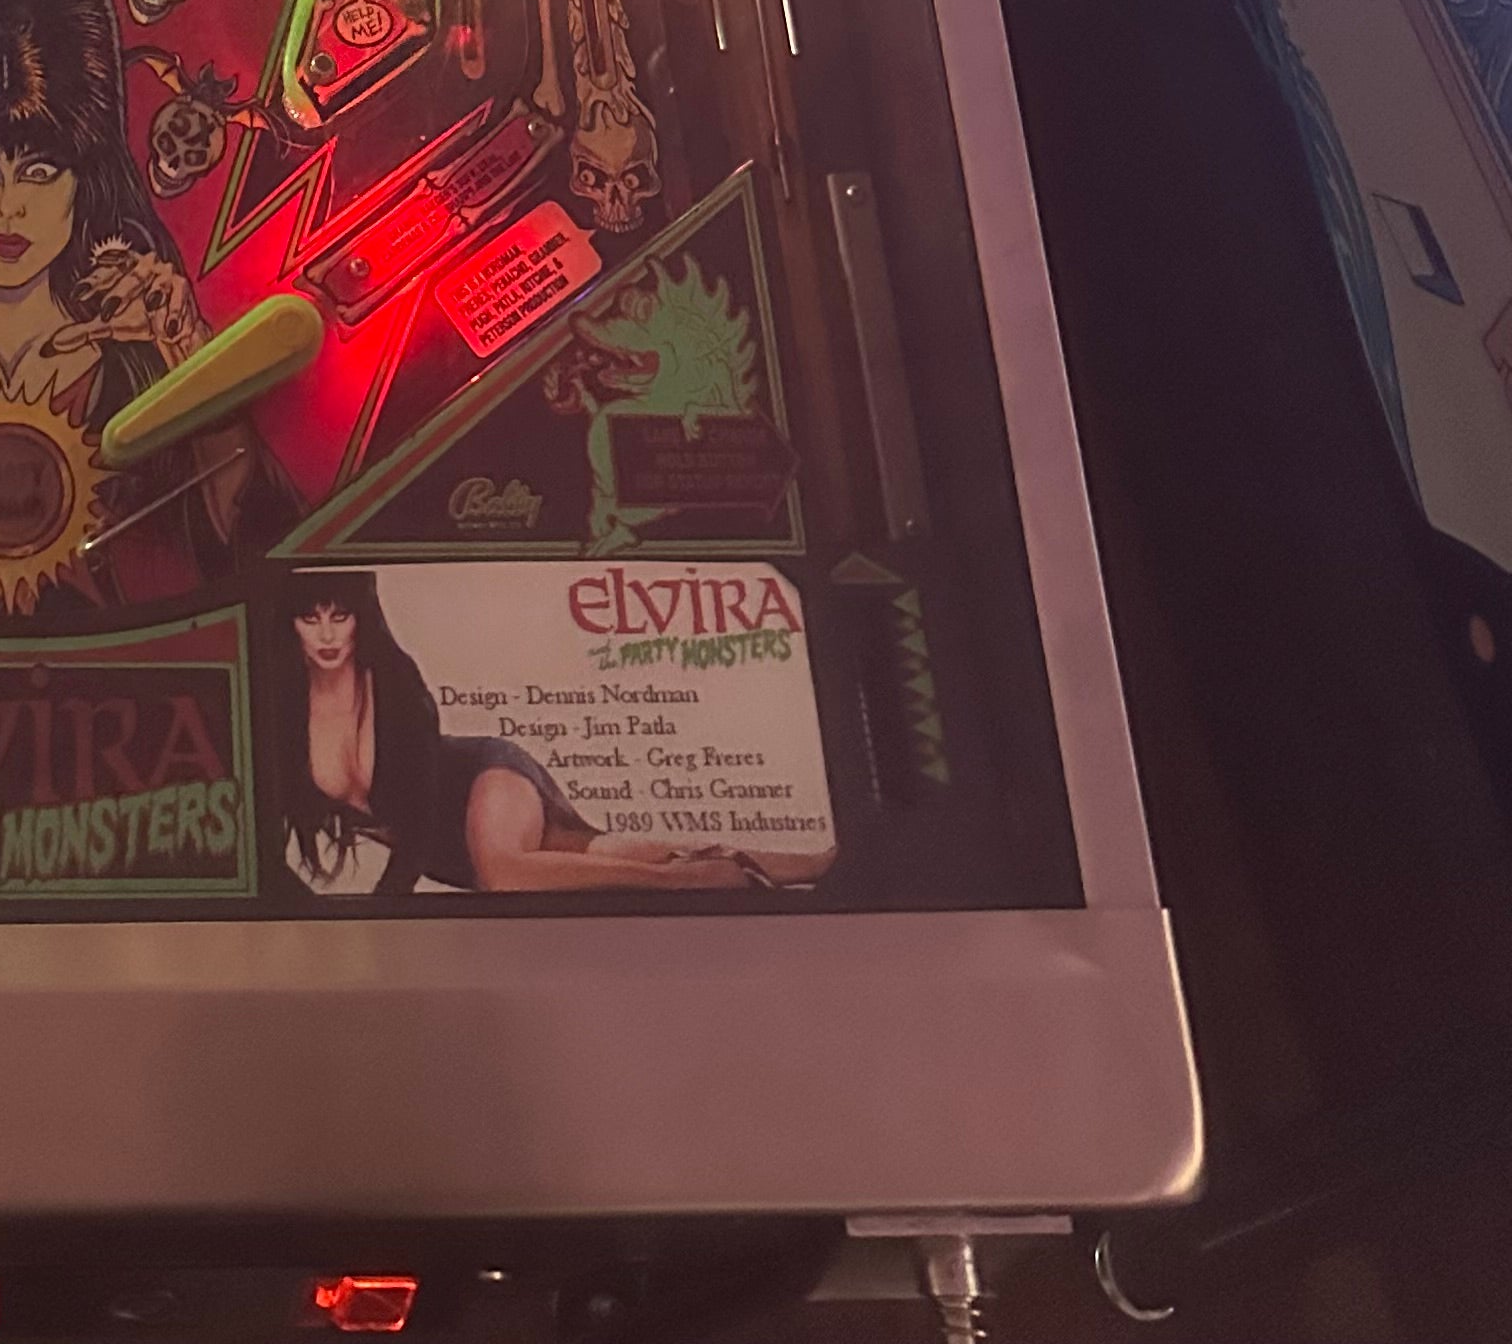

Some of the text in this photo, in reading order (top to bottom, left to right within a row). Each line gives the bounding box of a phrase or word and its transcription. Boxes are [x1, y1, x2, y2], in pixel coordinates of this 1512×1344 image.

[341, 5, 375, 23] HELP
[351, 12, 383, 40] ME!
[620, 628, 793, 670] PARTY MONSTERS
[440, 684, 700, 709] Design Dennis Nordman
[499, 716, 568, 741] Design
[582, 716, 622, 741] Jim
[546, 748, 765, 774] Artwork Greg Freres
[567, 780, 794, 801] Sound Chris Granner
[603, 810, 828, 834] 1989 WMS Industries
